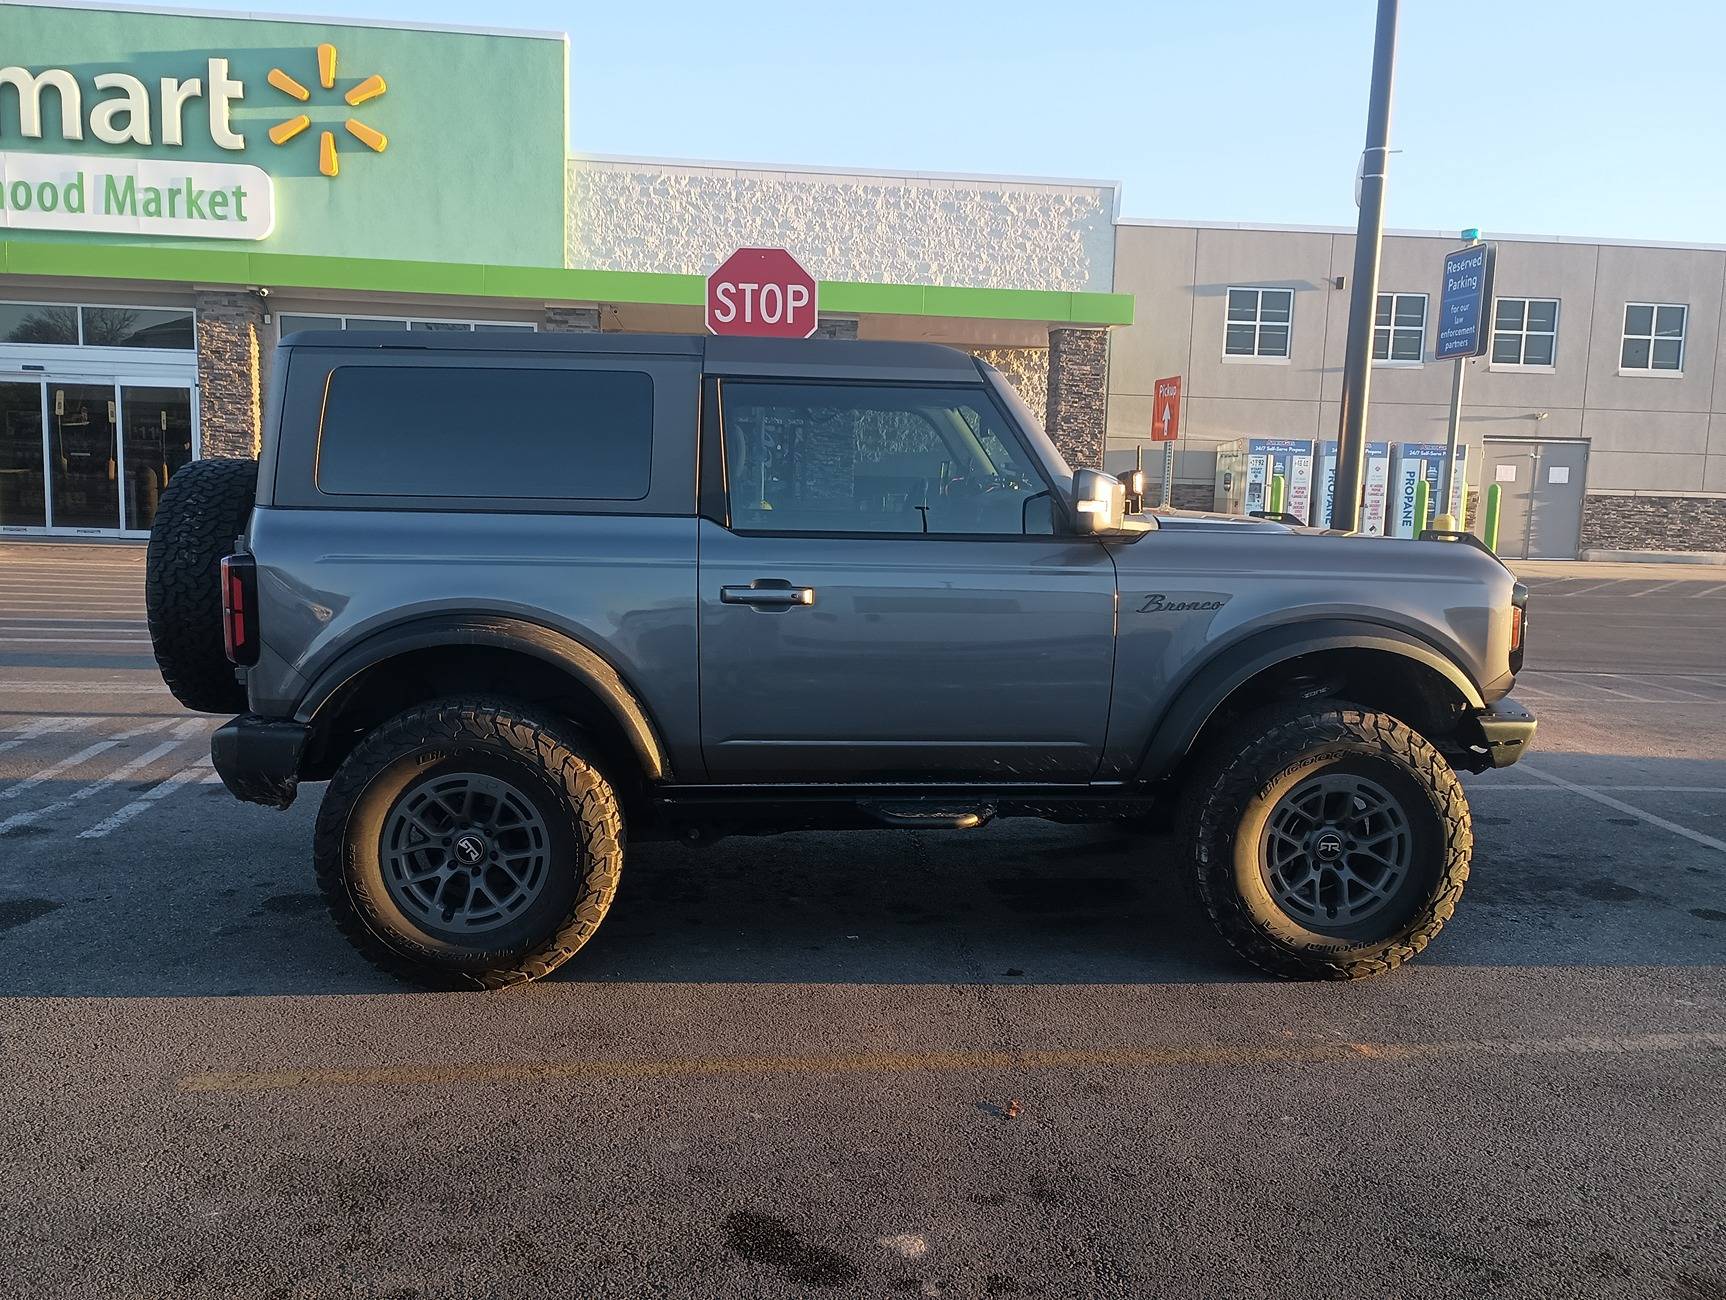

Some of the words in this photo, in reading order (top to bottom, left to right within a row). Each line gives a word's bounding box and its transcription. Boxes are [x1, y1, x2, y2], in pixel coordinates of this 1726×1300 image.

[0, 171, 86, 214] ood
[103, 173, 248, 222] Market
[1447, 253, 1482, 273] Reserved
[1448, 276, 1477, 291] Parking
[714, 282, 810, 324] STOP
[1450, 304, 1460, 315] for
[1460, 302, 1470, 313] our
[1454, 316, 1464, 325] law
[1440, 326, 1475, 338] enforcement
[1445, 339, 1468, 351] partners
[1158, 384, 1177, 399] Pickup
[1402, 471, 1416, 527] PROPANE
[1136, 593, 1225, 614] Bronco
